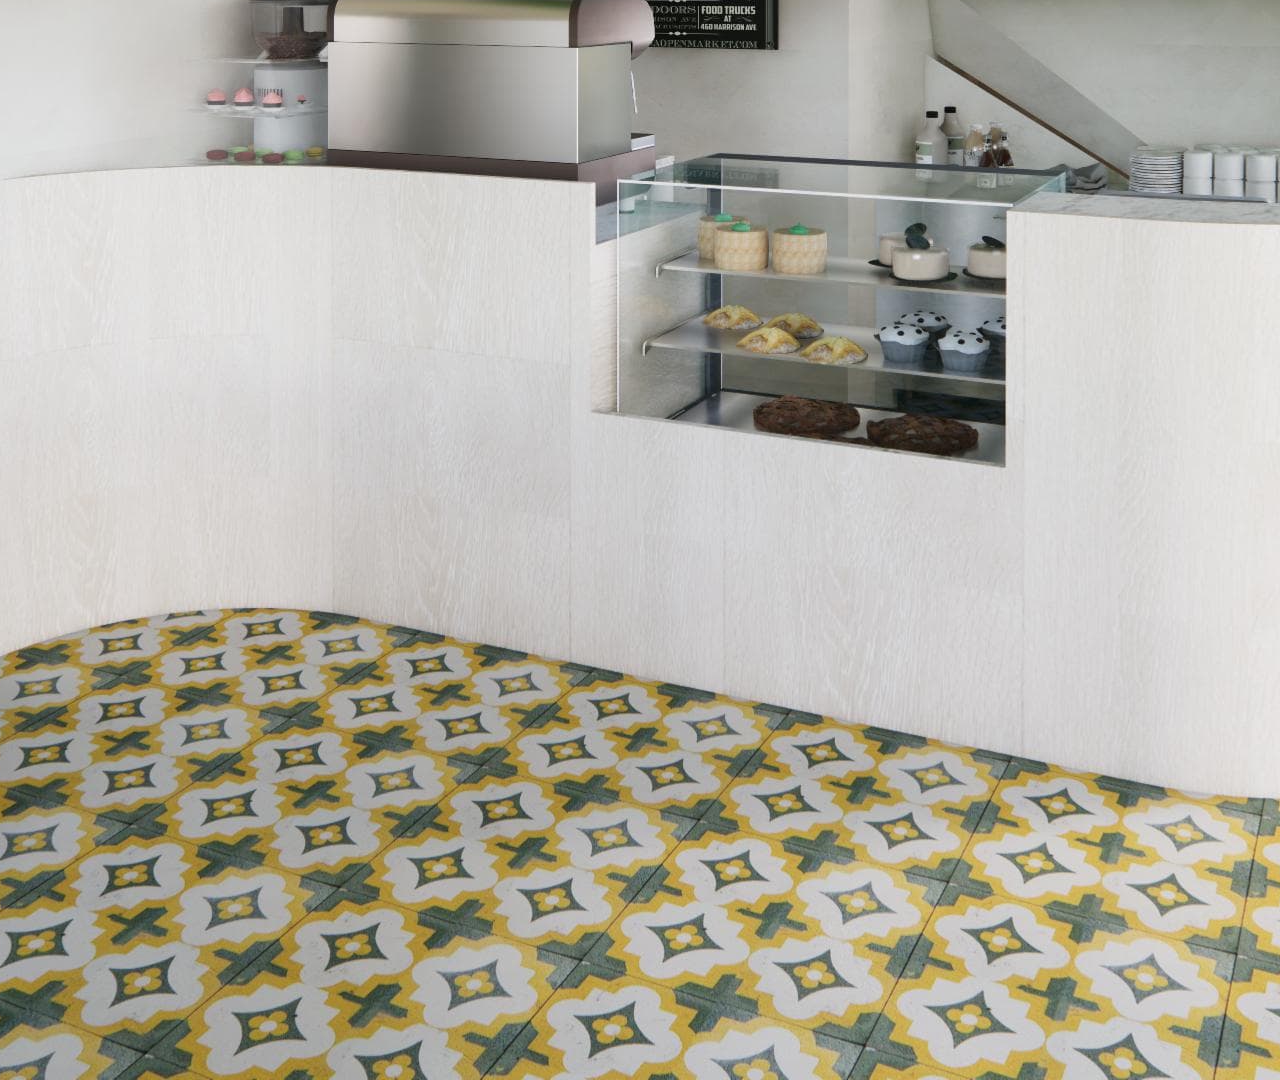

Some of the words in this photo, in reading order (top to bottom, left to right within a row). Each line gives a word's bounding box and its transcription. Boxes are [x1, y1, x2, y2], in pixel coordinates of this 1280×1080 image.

[653, 5, 697, 14] DOORS
[701, 5, 723, 15] FOOD
[724, 5, 756, 15] TRUCKS
[714, 23, 745, 31] HARRISON
[745, 23, 757, 31] AVE
